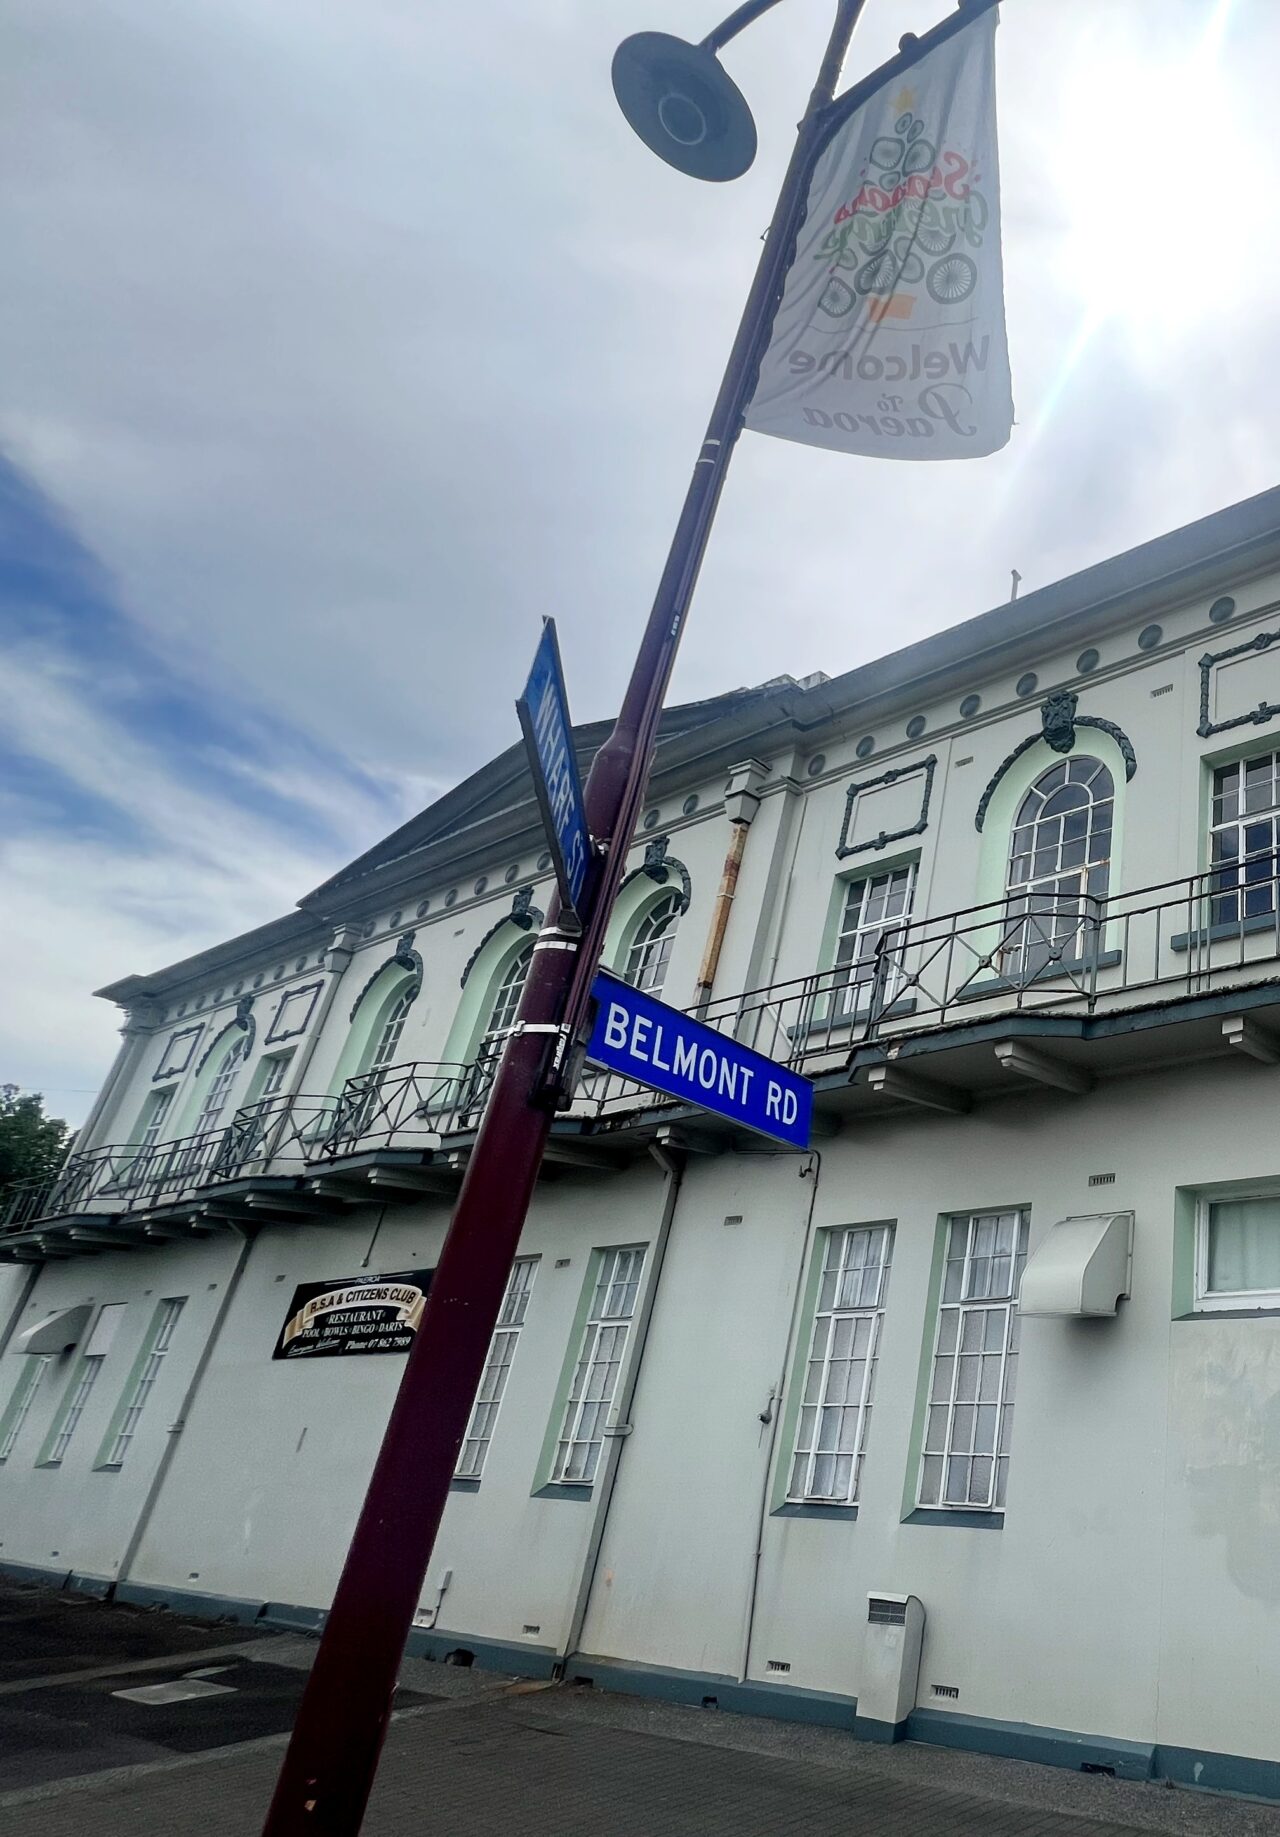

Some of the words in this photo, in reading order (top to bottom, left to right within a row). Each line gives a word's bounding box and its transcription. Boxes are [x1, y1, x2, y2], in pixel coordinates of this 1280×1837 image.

[535, 671, 575, 838] WHARF
[604, 1002, 755, 1106] BELMONT
[766, 1080, 799, 1126] RD
[336, 1293, 343, 1305] &
[346, 1287, 389, 1304] CITIZENS
[390, 1287, 417, 1305] CLUB
[328, 1310, 384, 1325] RESTAURANT
[324, 1326, 349, 1337] BOWLS
[351, 1324, 376, 1335] BINGO
[379, 1321, 405, 1334] DARTS
